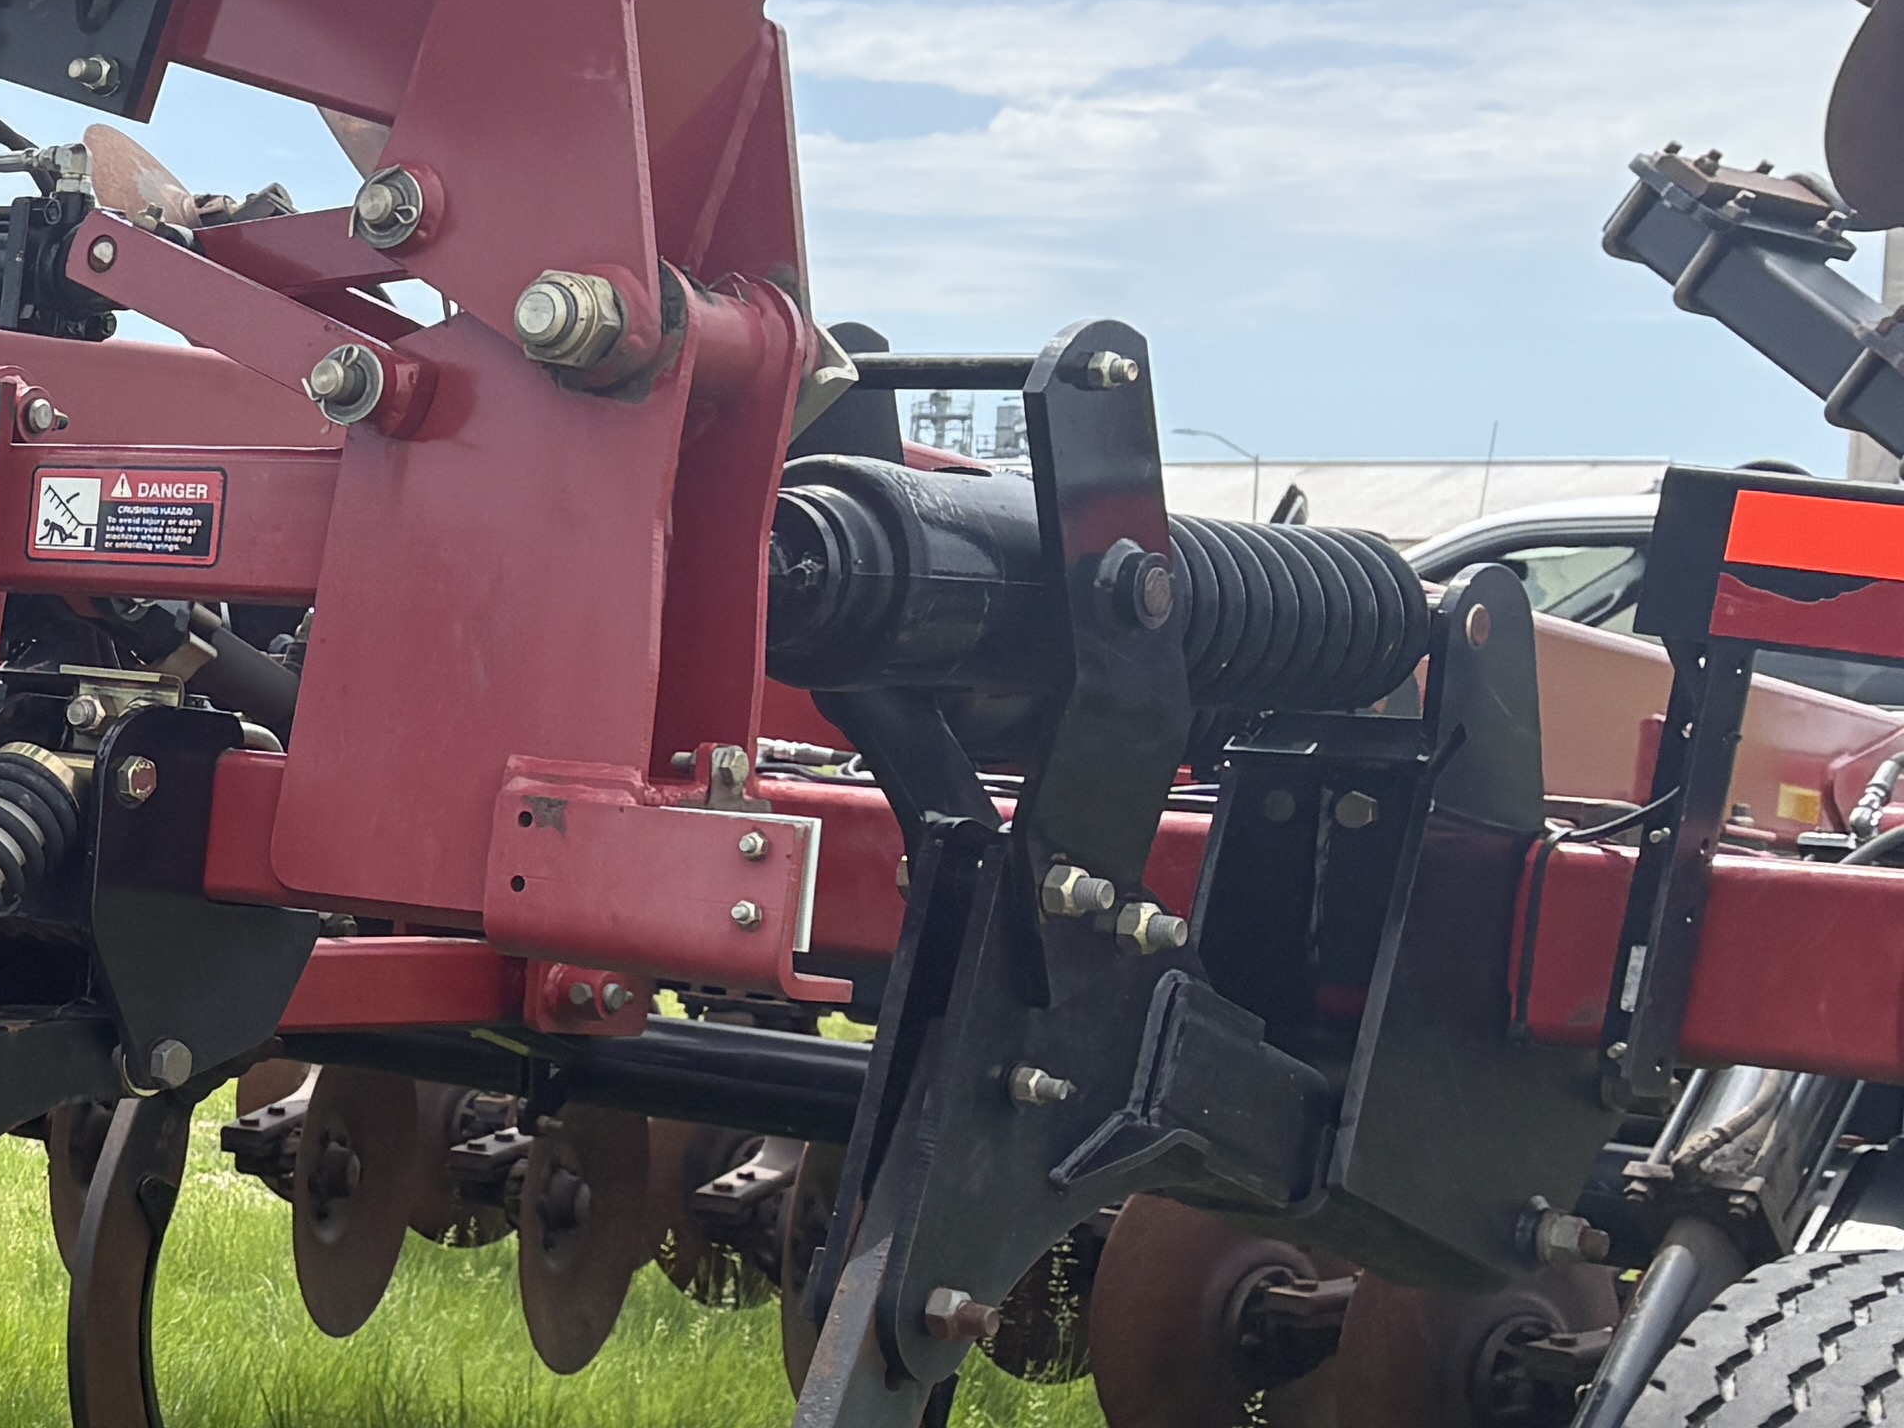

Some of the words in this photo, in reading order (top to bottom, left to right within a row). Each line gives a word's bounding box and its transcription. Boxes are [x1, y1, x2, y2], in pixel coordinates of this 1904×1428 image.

[137, 482, 208, 499] DANGER
[117, 505, 159, 515] CRUSHING
[159, 506, 194, 516] HAZARD
[107, 515, 117, 524] To
[118, 517, 141, 525] avoid
[141, 517, 166, 527] injury
[167, 518, 177, 526] or
[178, 518, 203, 527] death
[105, 525, 126, 533] keep
[127, 526, 164, 535] everyone
[165, 526, 186, 534] clear
[187, 526, 197, 535] of
[104, 533, 139, 541] machine
[140, 534, 162, 542] when
[163, 534, 193, 545] folding
[114, 541, 153, 551] unfolding
